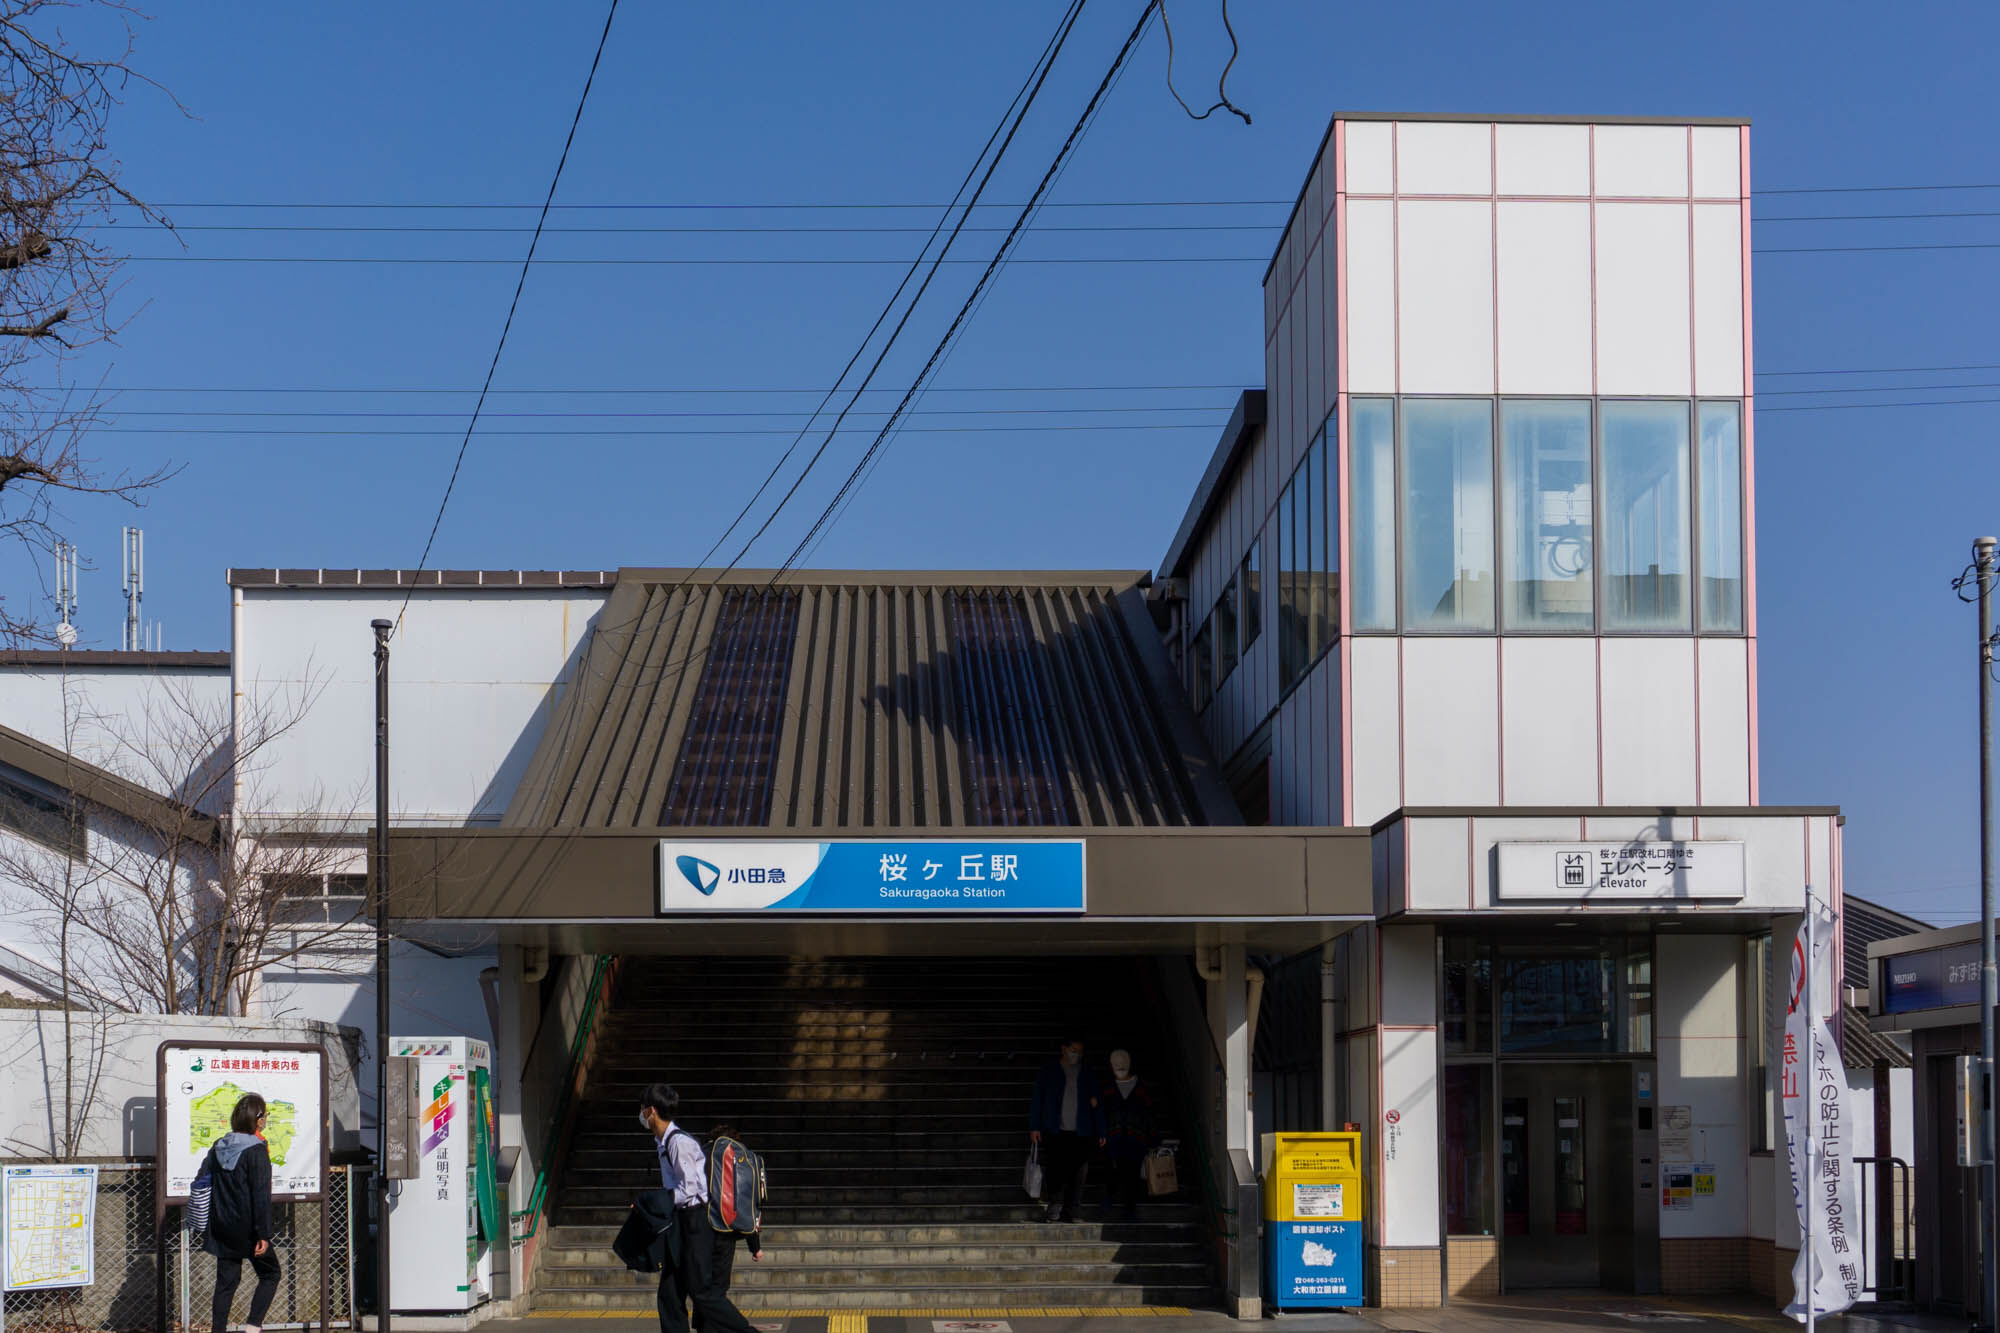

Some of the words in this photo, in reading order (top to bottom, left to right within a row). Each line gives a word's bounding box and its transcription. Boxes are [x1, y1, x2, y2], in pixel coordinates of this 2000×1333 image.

[728, 867, 786, 884] 小田急
[879, 853, 1018, 882] 桜ヶ丘駅
[1600, 861, 1693, 876] エレベーター
[1600, 877, 1647, 888] Elevator
[879, 887, 959, 899] Sakuragaoka
[963, 886, 1006, 898] Station
[211, 1059, 300, 1071] 広域避難場所案内板
[436, 1147, 449, 1200] 証明写真
[1839, 1263, 1858, 1300] 制定
